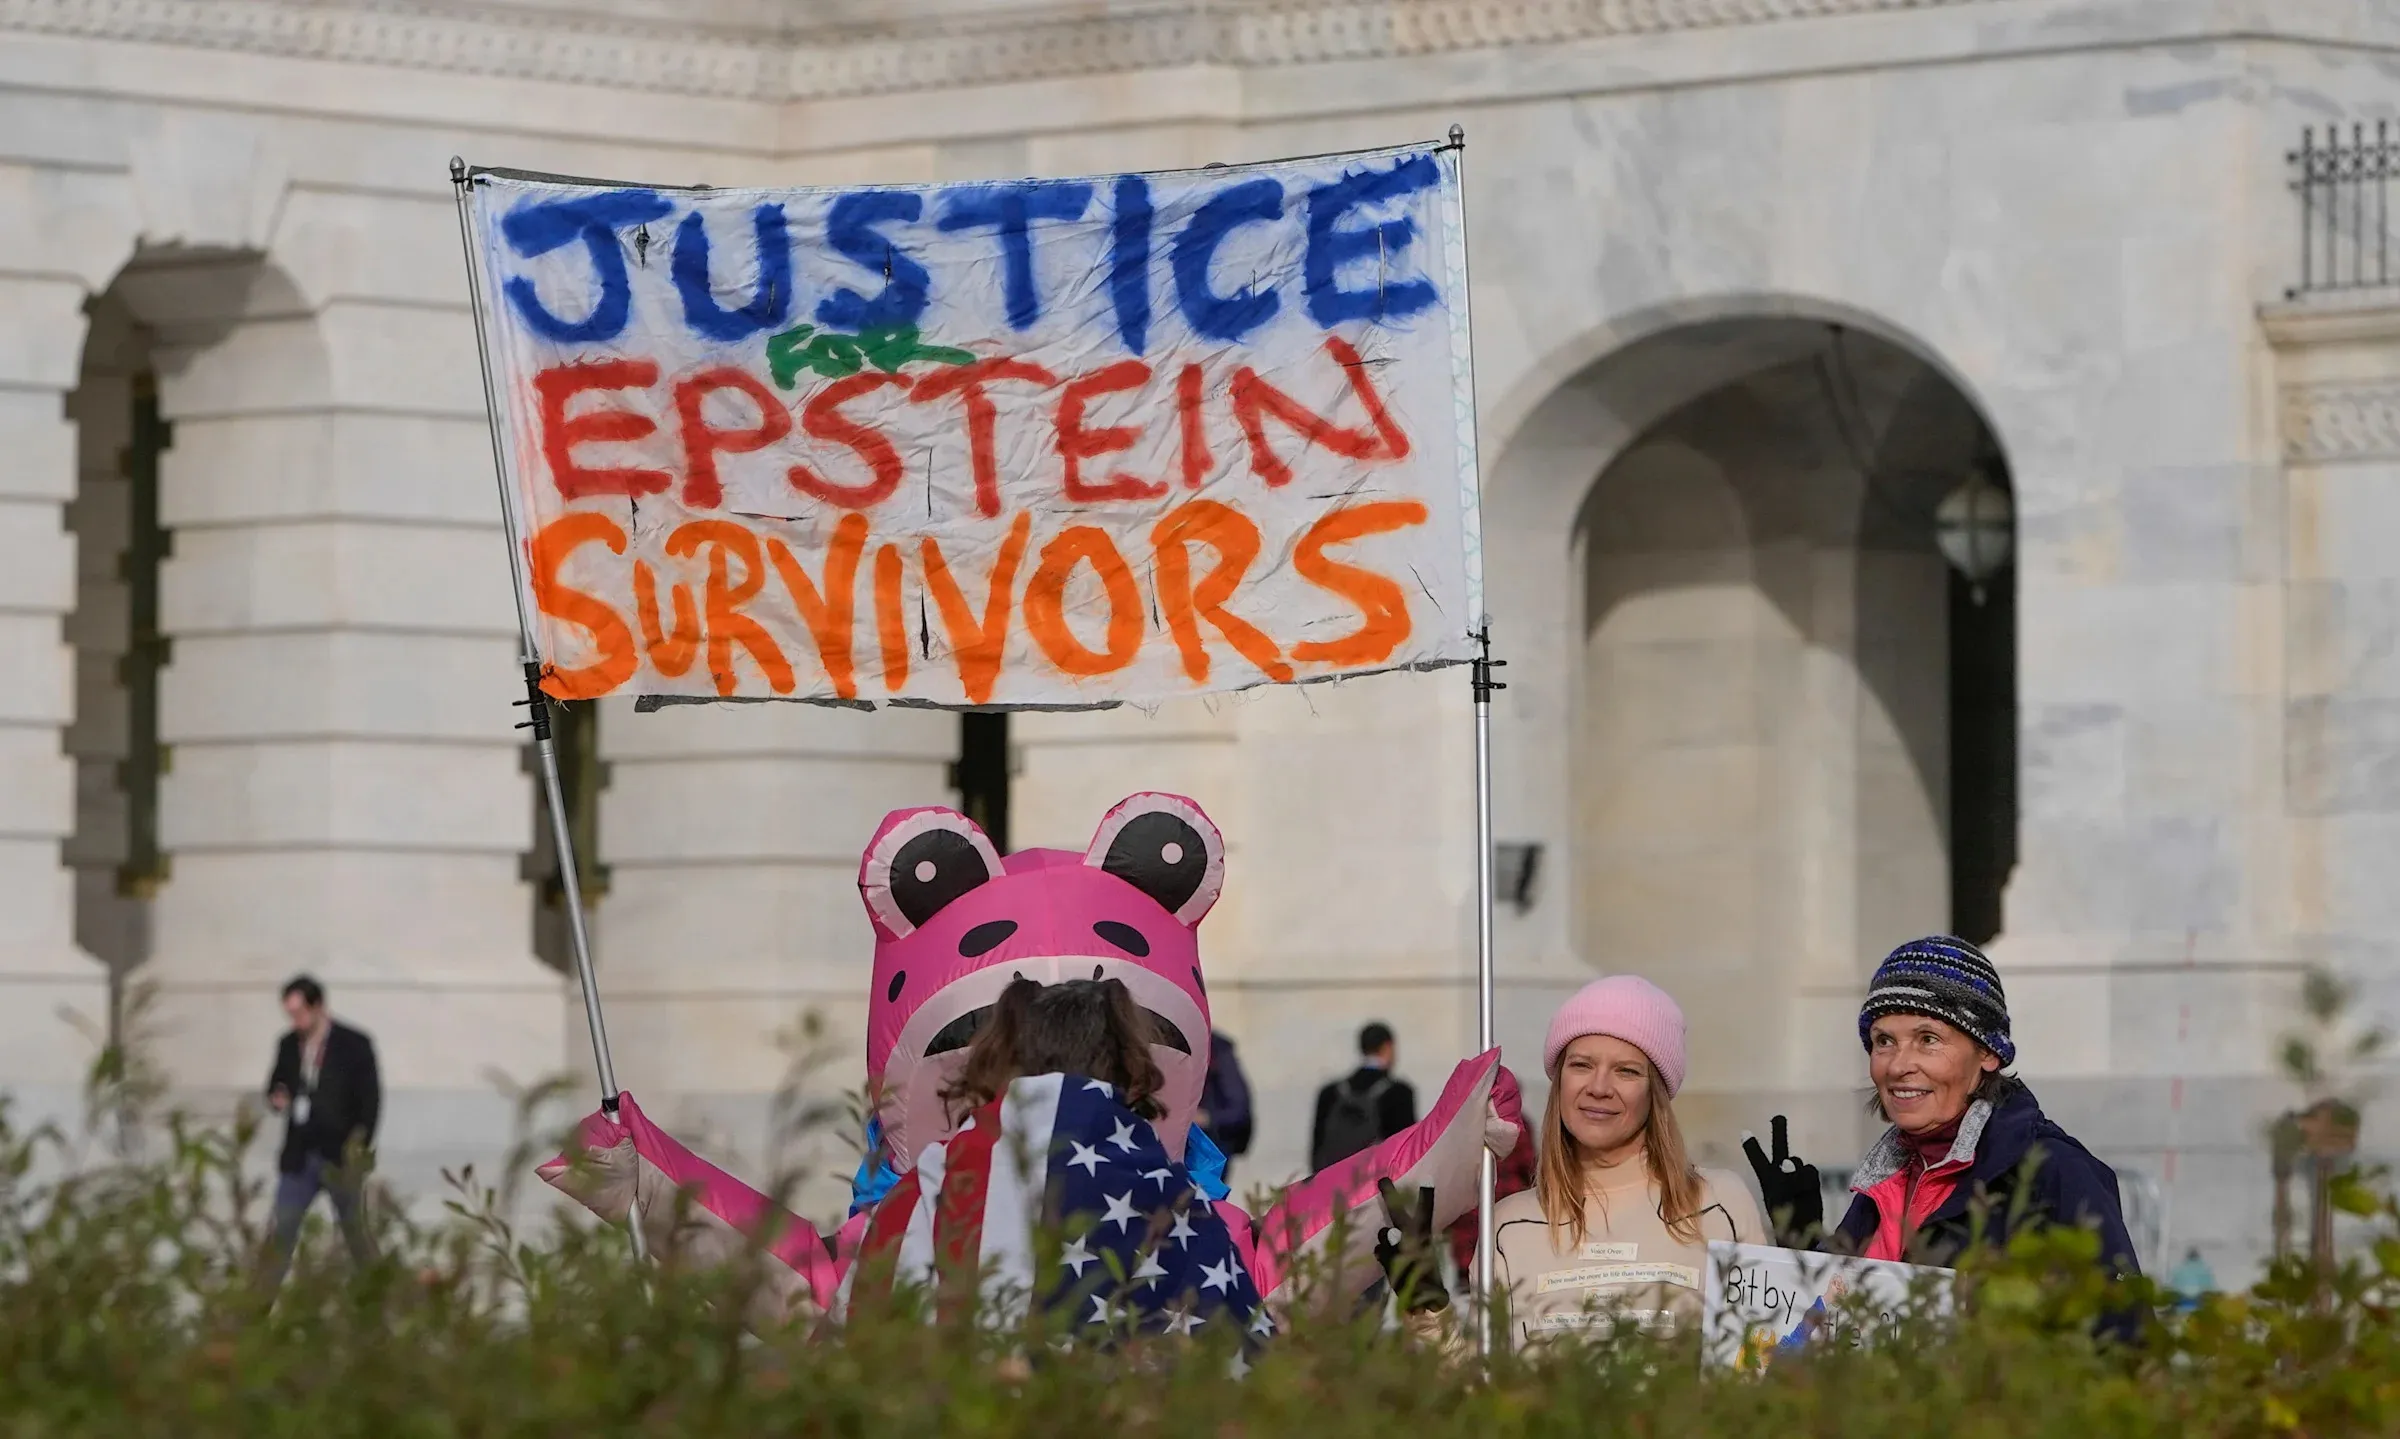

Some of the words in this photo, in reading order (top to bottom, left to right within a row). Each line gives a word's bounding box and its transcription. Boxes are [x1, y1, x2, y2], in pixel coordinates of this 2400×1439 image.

[502, 154, 1443, 355] JUSTICE
[532, 335, 1412, 519] EPSTEIN
[766, 321, 976, 389] FOR
[526, 500, 1428, 704] SURVIVORS
[1726, 1265, 1758, 1306] Bit
[1764, 1270, 1796, 1324] by
